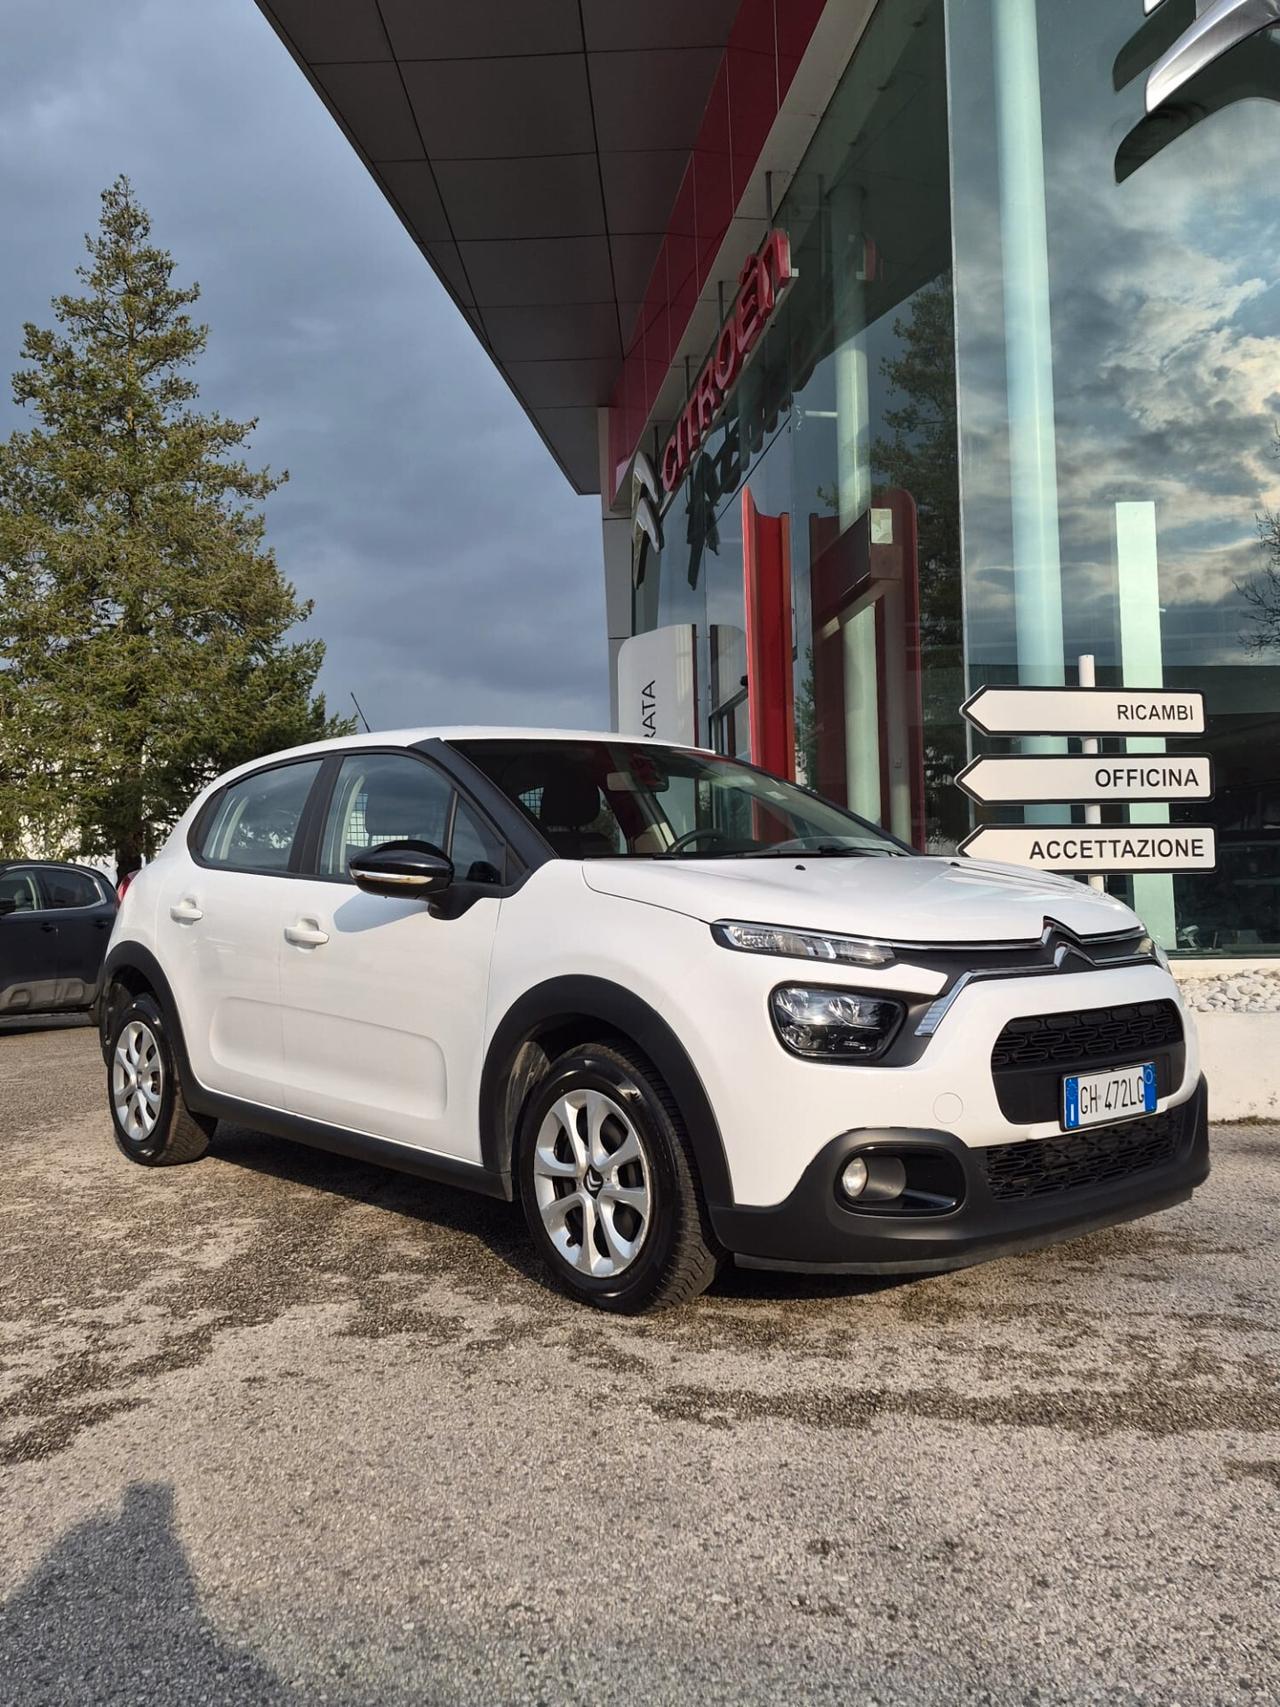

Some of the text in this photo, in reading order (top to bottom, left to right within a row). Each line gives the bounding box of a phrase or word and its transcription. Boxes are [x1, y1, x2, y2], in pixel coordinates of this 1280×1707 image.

[1117, 704, 1194, 721] RICAMBI
[1095, 768, 1199, 788] OFFICINA
[1029, 838, 1205, 860] ACCETTAZIONE
